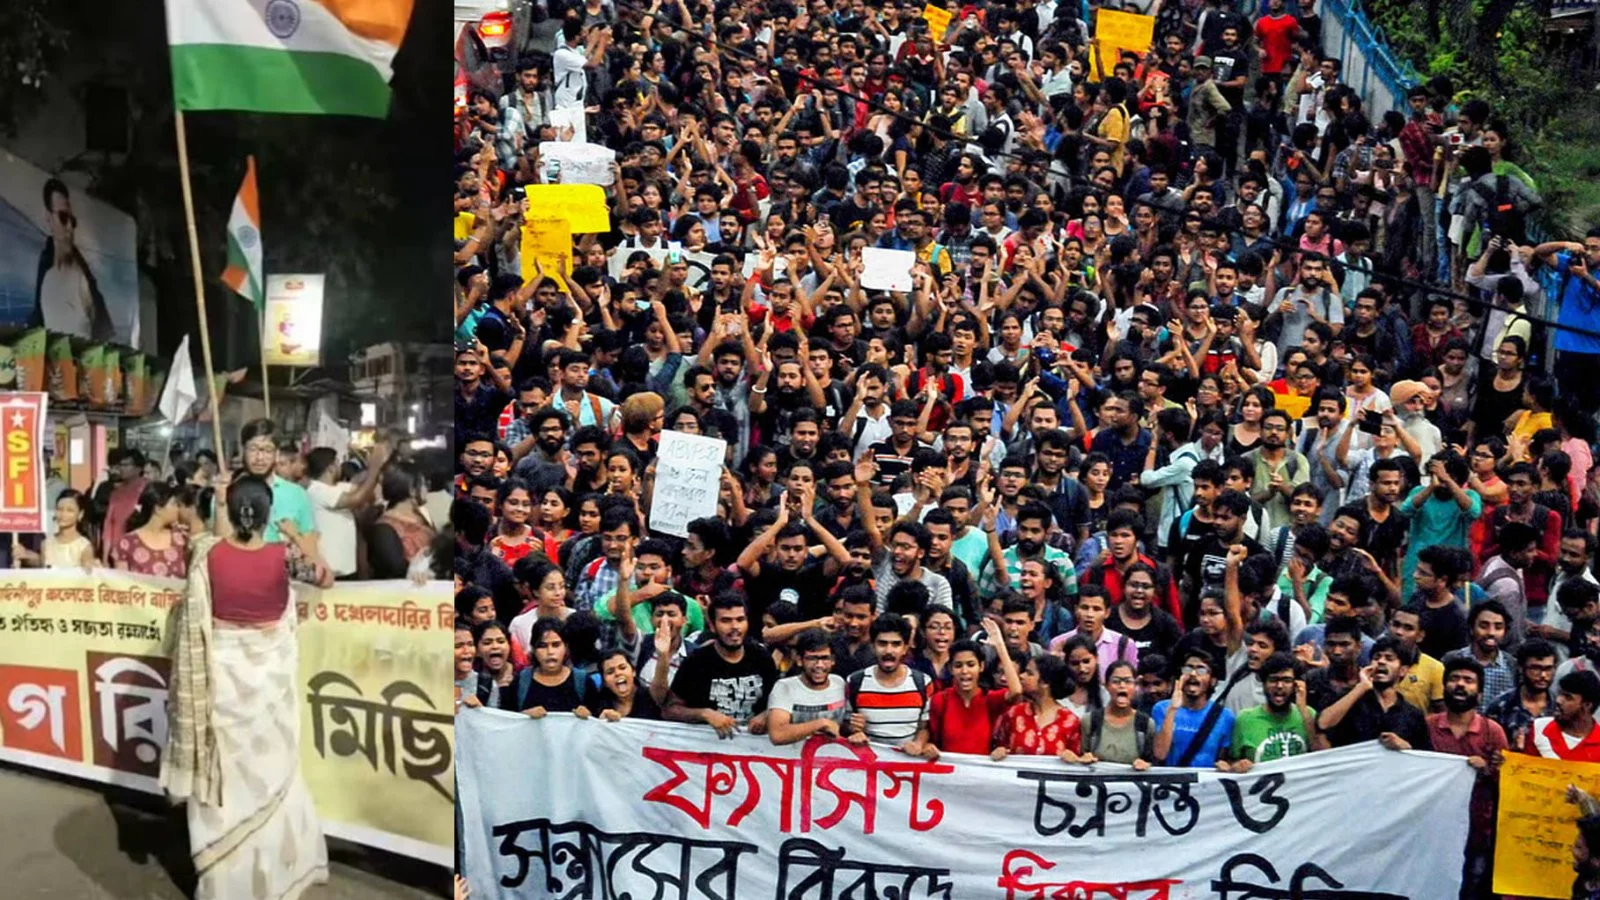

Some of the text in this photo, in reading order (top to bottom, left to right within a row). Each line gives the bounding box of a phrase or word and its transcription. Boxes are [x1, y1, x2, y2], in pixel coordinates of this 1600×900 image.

[7, 430, 31, 506] SFI
[58, 619, 68, 634] ও
[98, 583, 146, 607] বিজেপি
[315, 602, 329, 622] ও
[334, 600, 432, 630] দখলদারির
[643, 736, 1290, 838] ফ্যাসিস্ট চক্রান্ত ও
